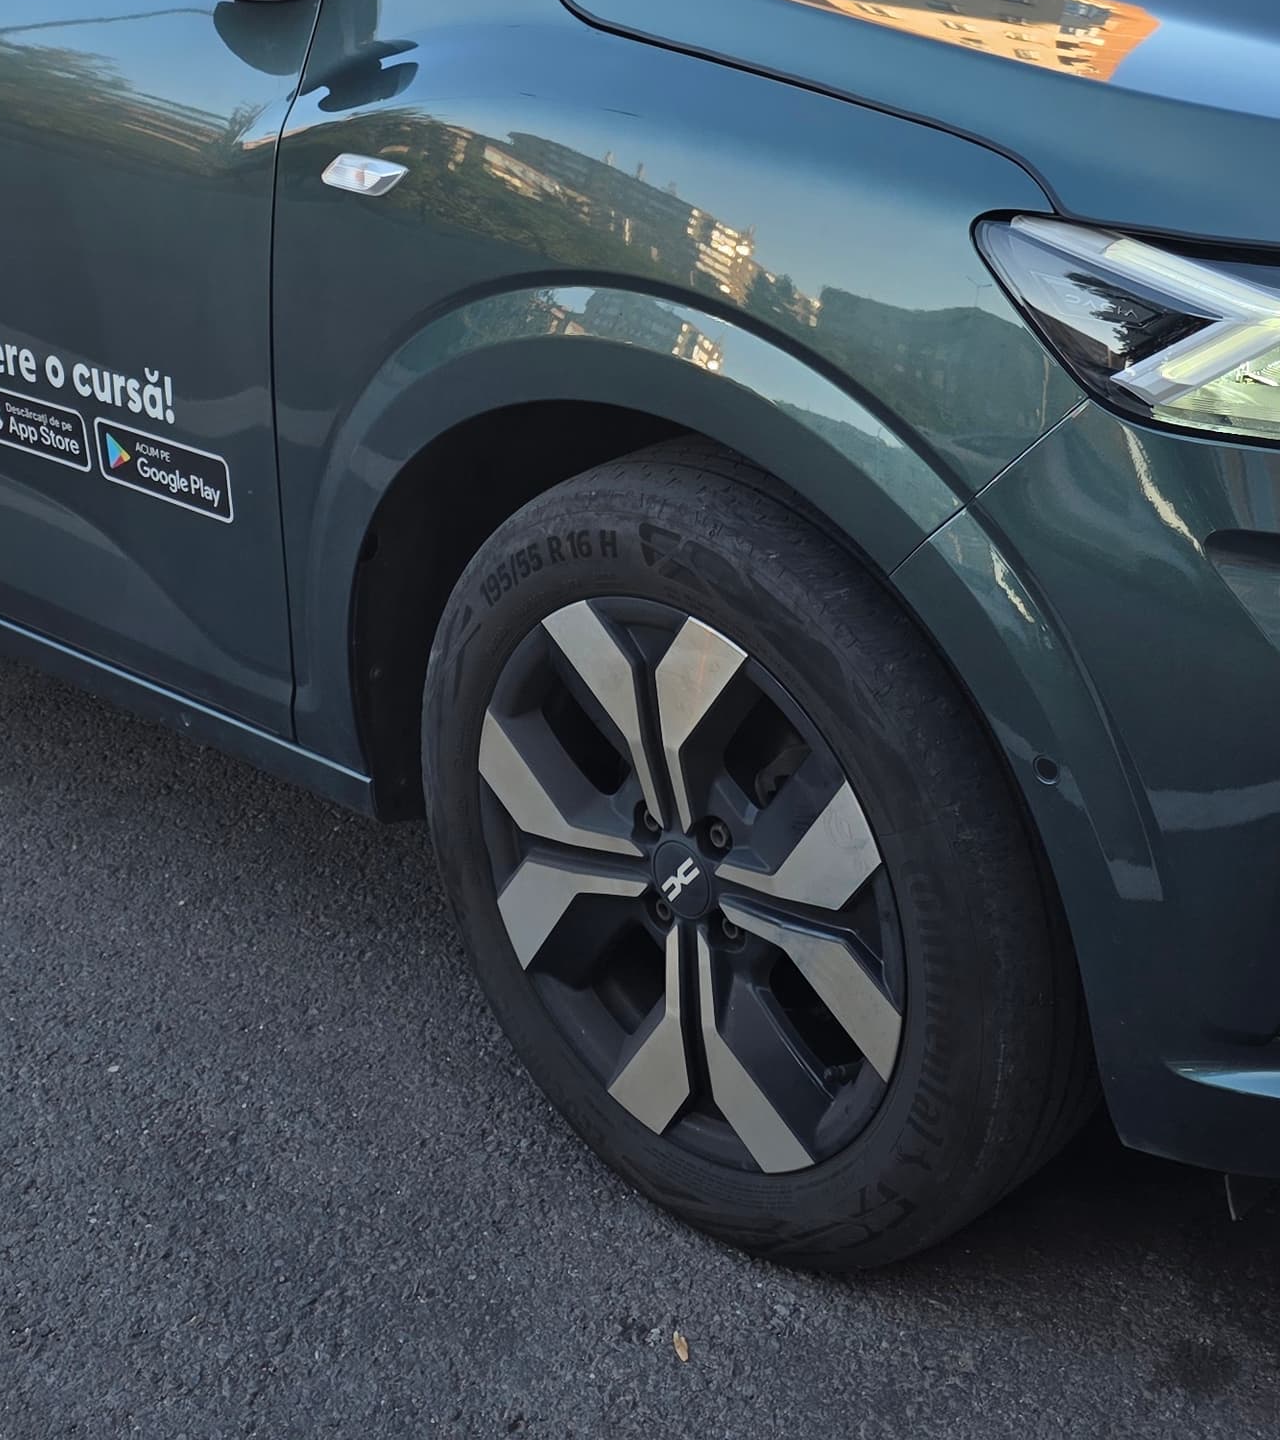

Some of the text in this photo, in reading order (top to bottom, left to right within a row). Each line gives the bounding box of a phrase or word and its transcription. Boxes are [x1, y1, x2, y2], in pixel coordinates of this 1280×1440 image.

[45, 355, 65, 389] o
[72, 367, 175, 424] cursă!
[9, 416, 80, 455] App Store
[49, 416, 60, 428] de
[61, 421, 72, 432] pe
[135, 442, 171, 463] ACUM PE
[137, 457, 221, 508] Google Play
[480, 530, 618, 608] 195/55 R 16 H
